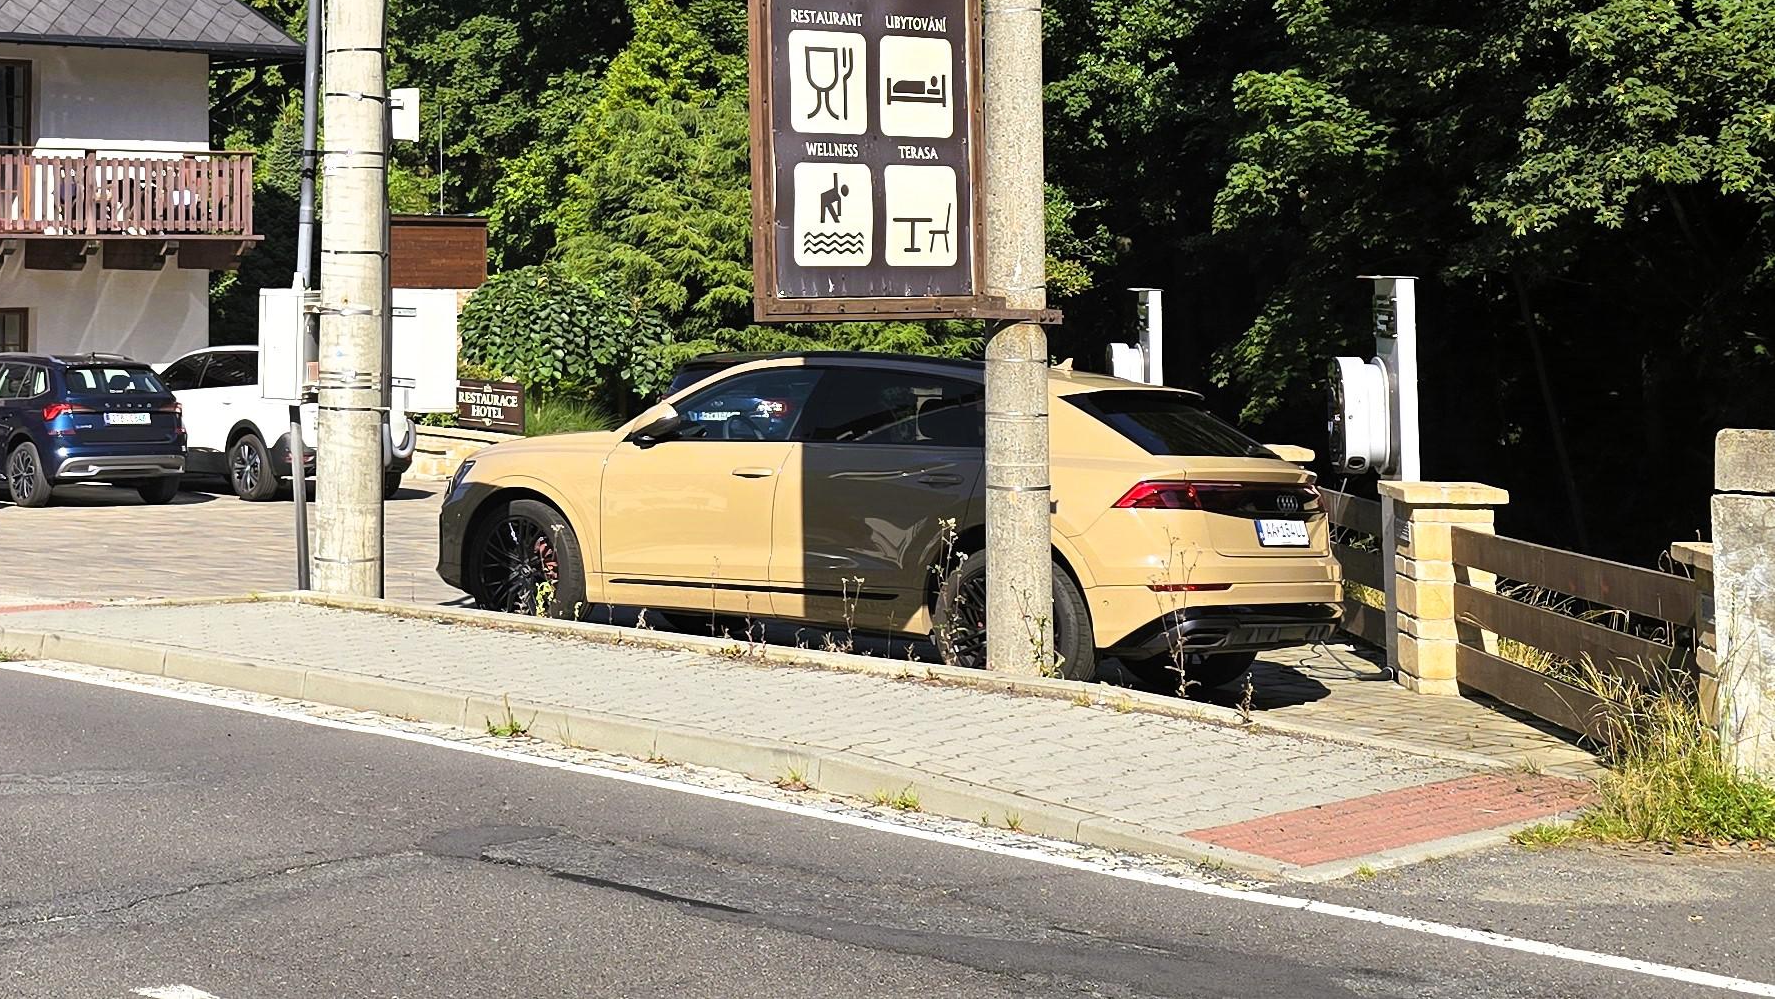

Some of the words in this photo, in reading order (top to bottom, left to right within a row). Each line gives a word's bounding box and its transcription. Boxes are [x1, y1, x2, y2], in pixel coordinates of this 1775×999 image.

[790, 8, 863, 27] RESTAURANT
[884, 14, 947, 33] UBYTOVÁNÍ
[805, 141, 859, 158] WELLNESS
[897, 145, 939, 160] TERASA
[458, 391, 519, 408] RESTAURACE
[471, 404, 505, 420] HOTEL
